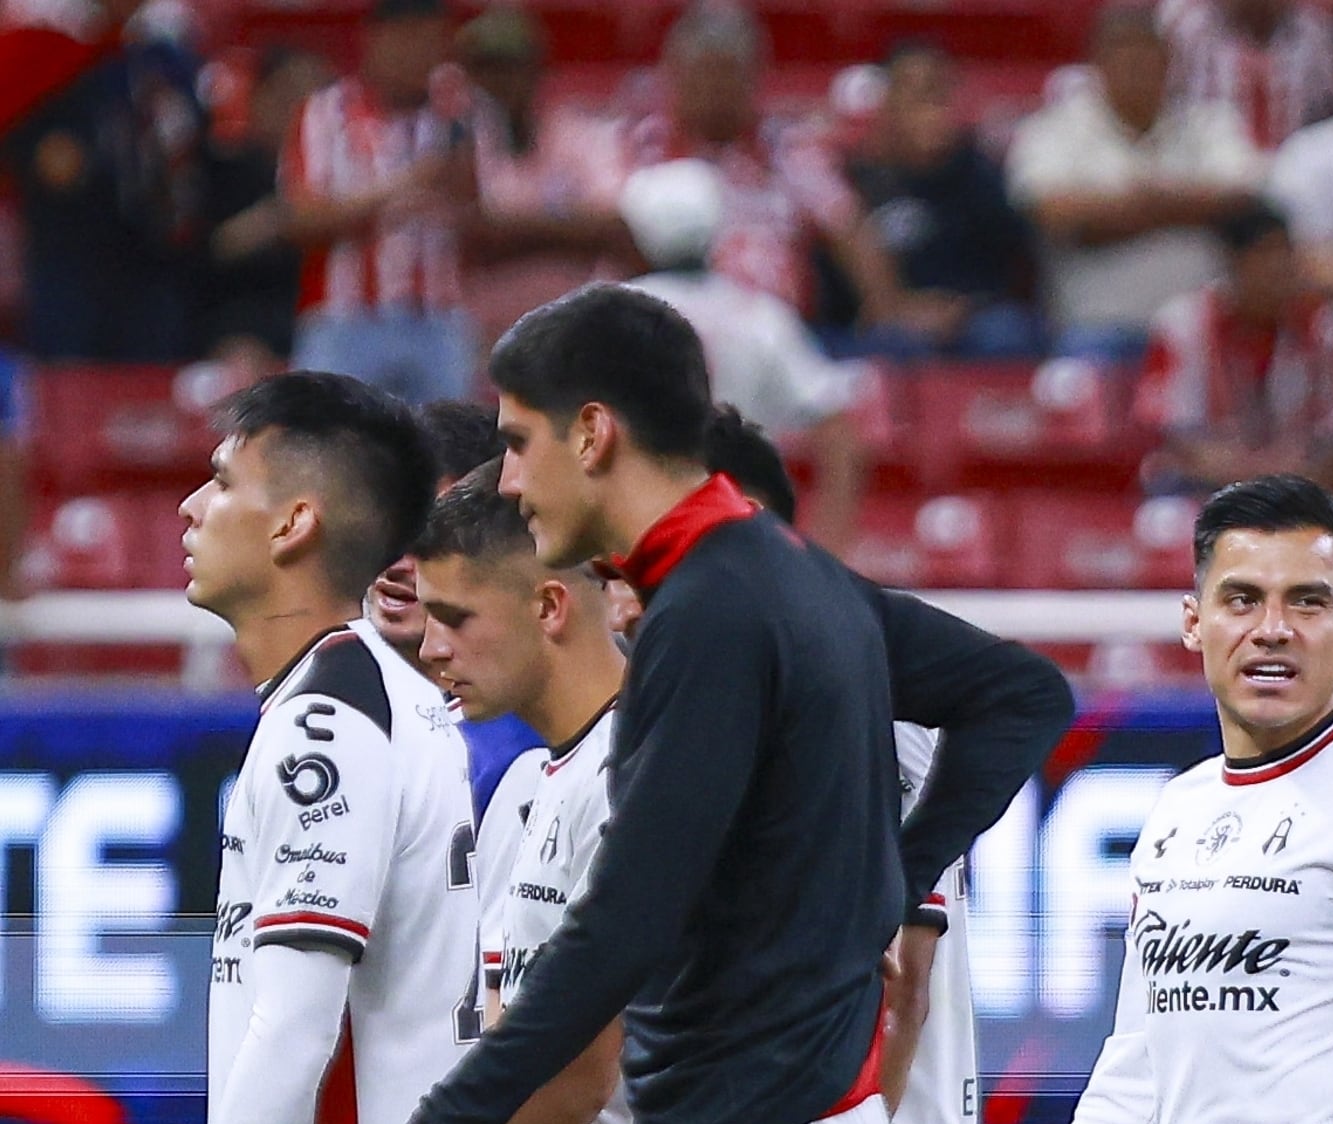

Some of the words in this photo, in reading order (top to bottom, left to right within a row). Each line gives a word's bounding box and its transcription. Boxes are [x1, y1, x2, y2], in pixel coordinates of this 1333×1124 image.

[297, 795, 351, 831] Berel
[274, 843, 348, 866] Omnibus
[297, 865, 316, 883] de
[1223, 875, 1300, 895] PERDURA
